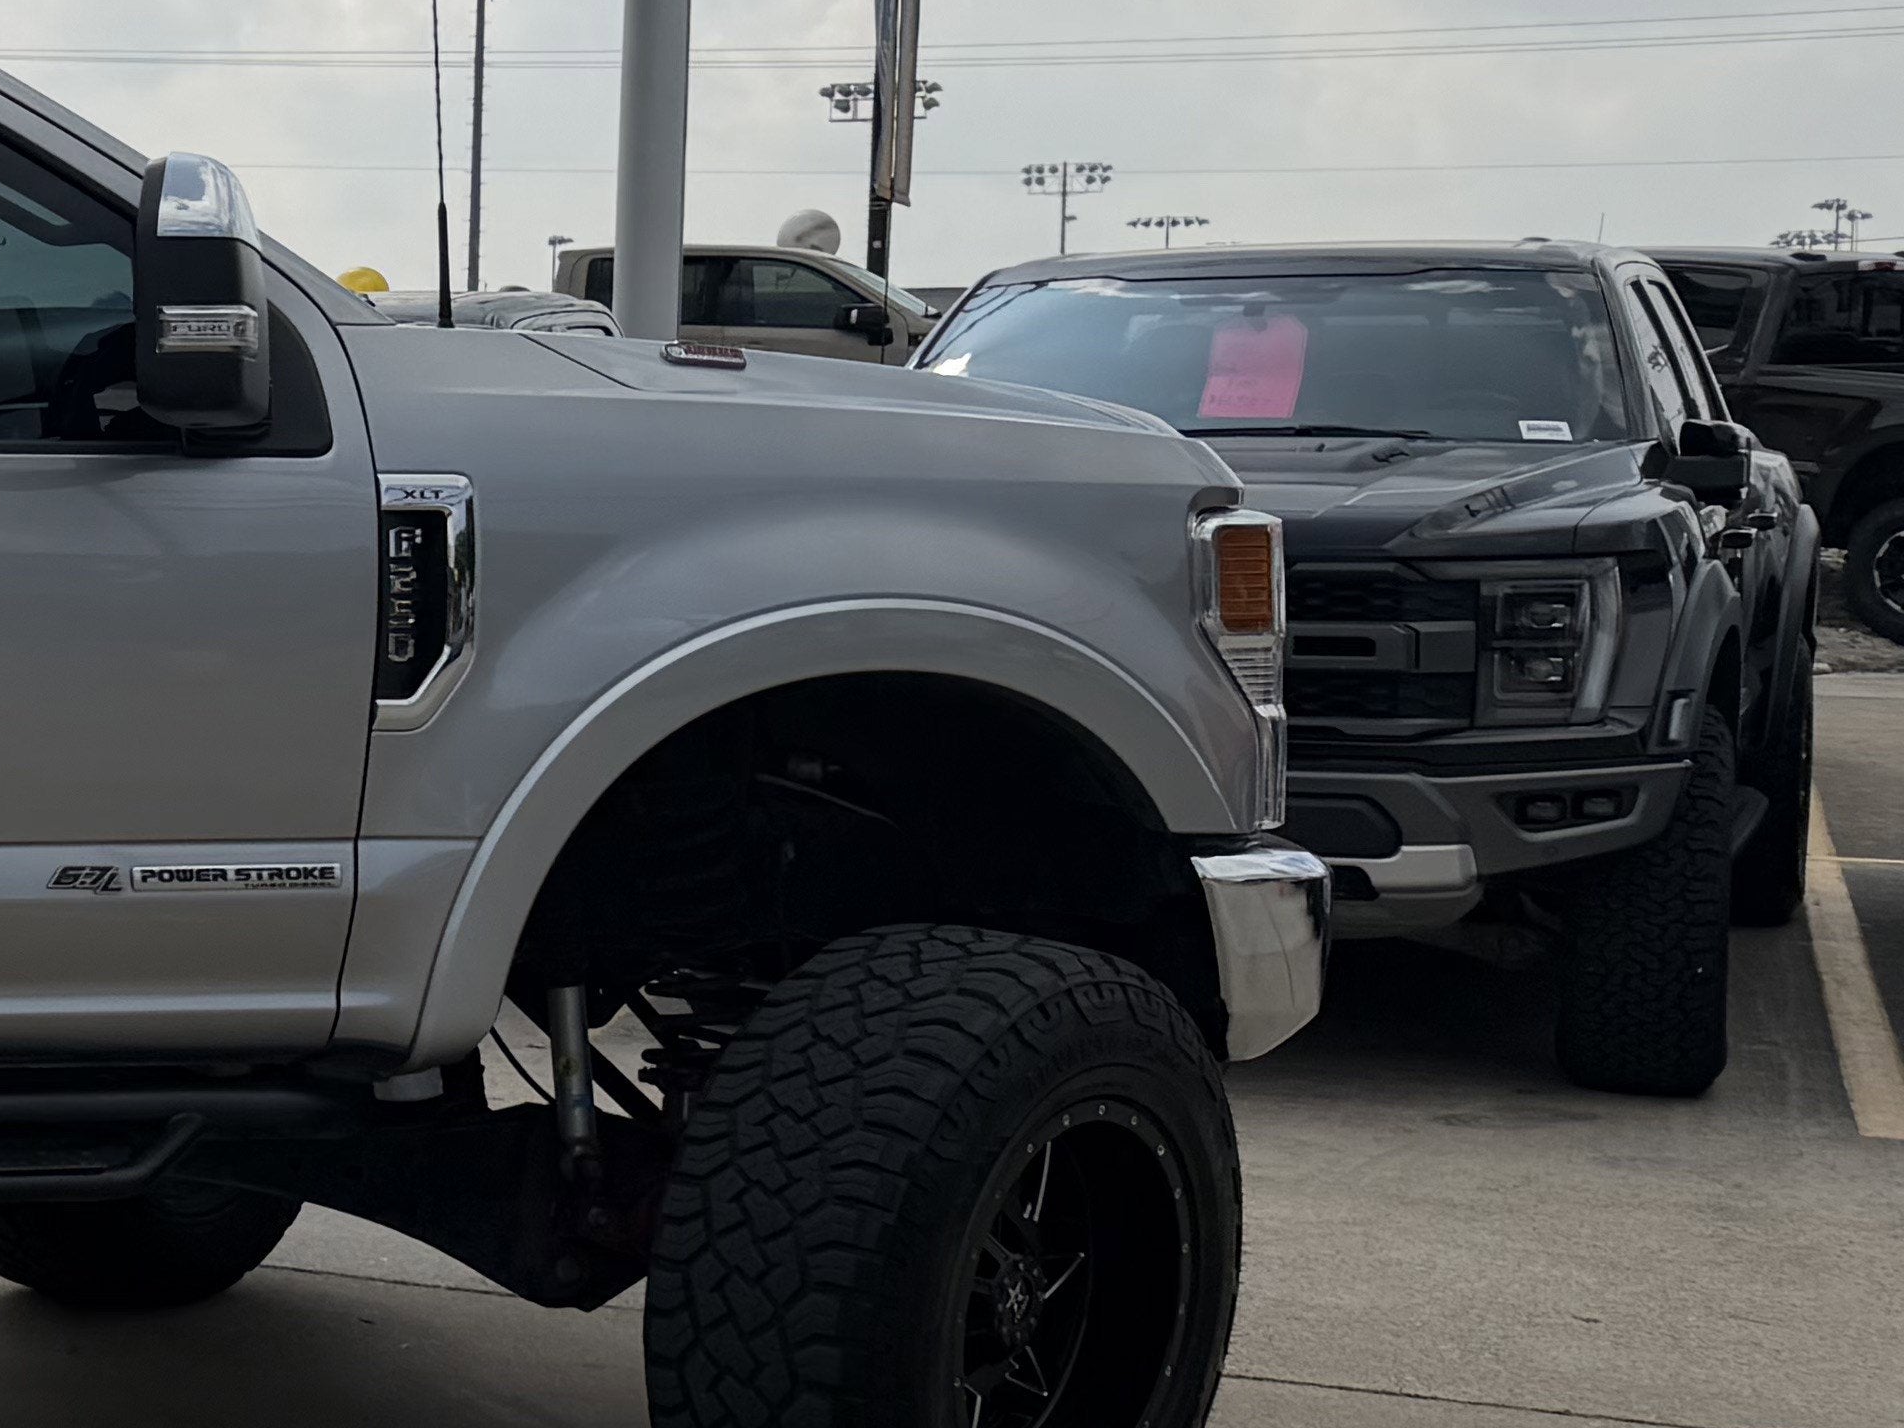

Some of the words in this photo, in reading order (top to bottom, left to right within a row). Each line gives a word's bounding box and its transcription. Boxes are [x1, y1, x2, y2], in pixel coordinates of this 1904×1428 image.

[402, 489, 444, 500] XLT
[47, 865, 123, 894] 6.7L
[140, 868, 229, 884] POWER
[234, 865, 336, 883] STROKE
